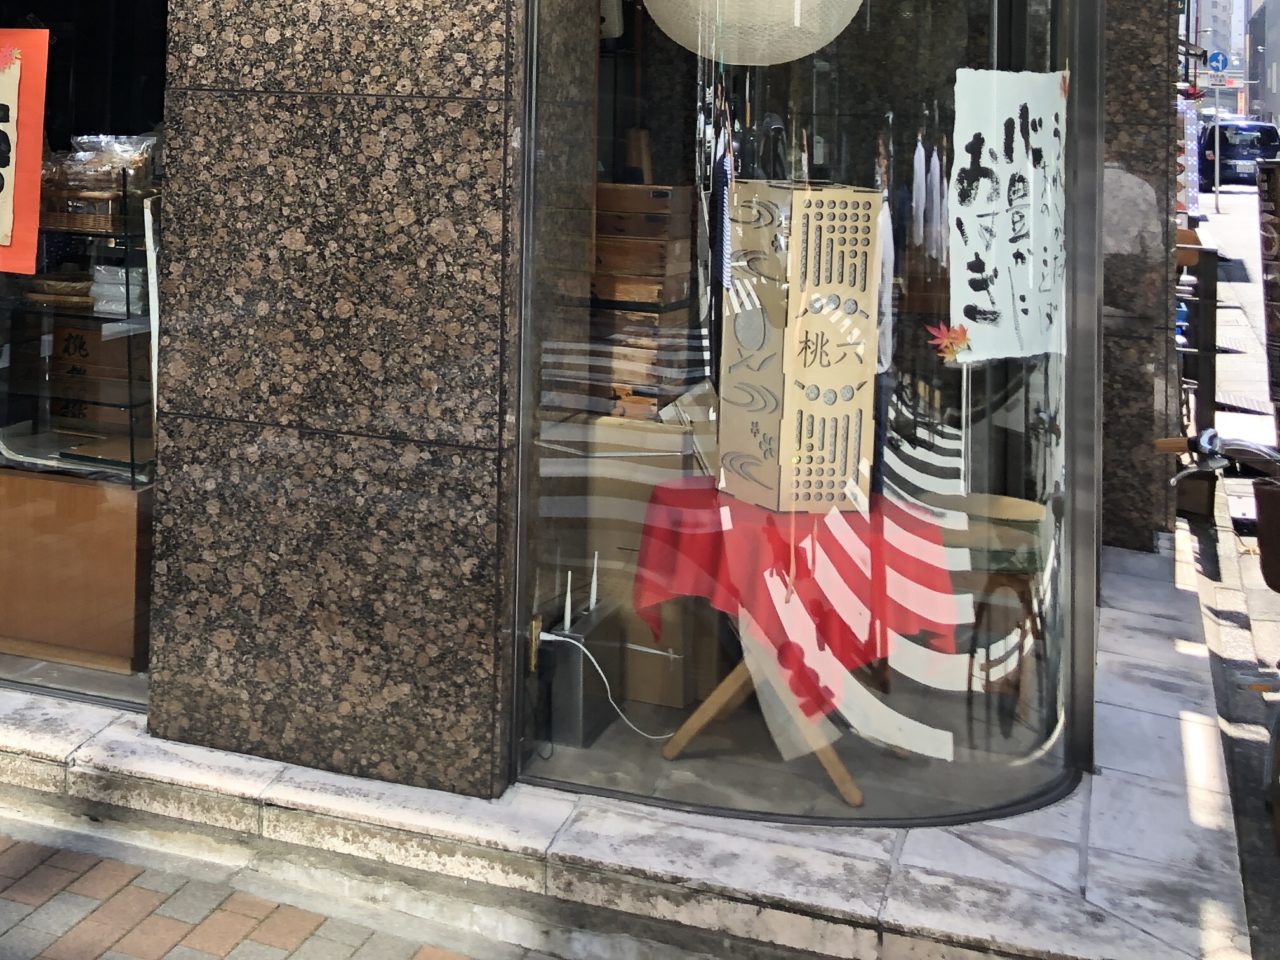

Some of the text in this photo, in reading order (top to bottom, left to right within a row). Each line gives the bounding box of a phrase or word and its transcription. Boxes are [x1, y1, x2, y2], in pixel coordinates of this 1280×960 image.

[955, 131, 1002, 328] おはぎ
[797, 329, 866, 370] 桃六
